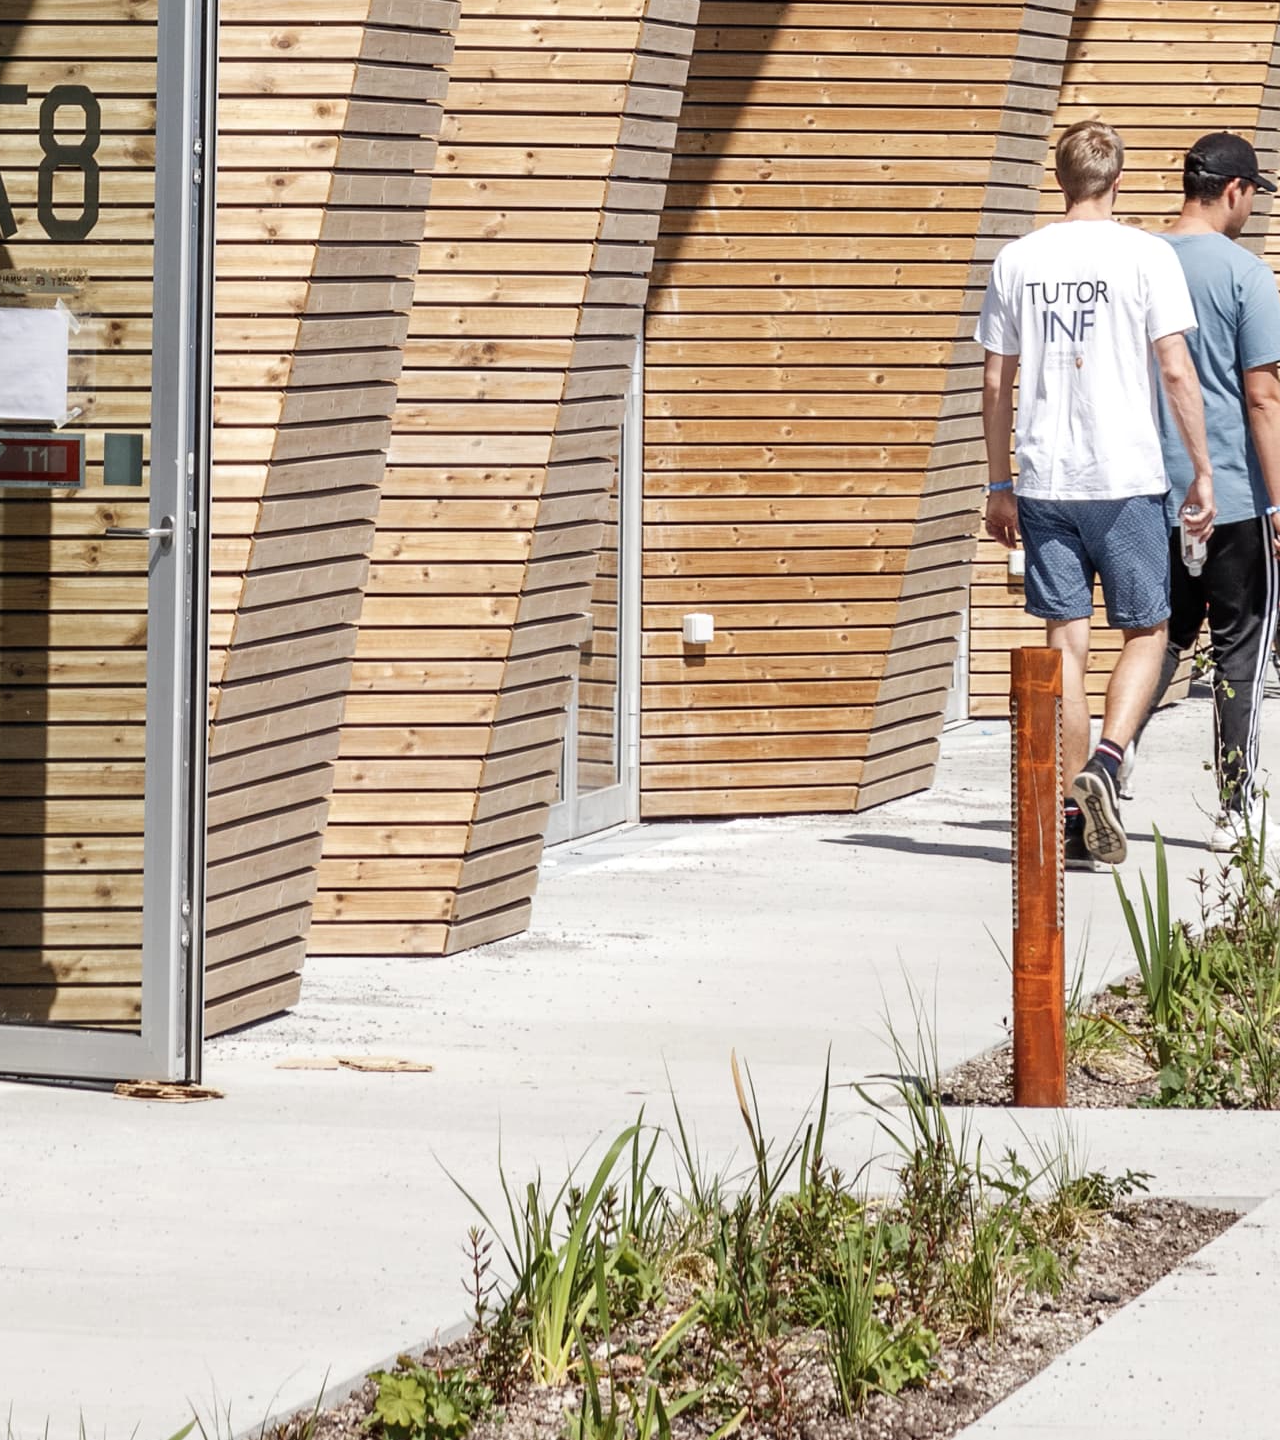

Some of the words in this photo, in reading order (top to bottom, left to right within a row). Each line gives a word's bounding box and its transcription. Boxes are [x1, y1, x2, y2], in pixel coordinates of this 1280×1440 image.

[1025, 280, 1109, 306] TUTOR
[1042, 309, 1095, 343] INF
[23, 446, 49, 472] T1
